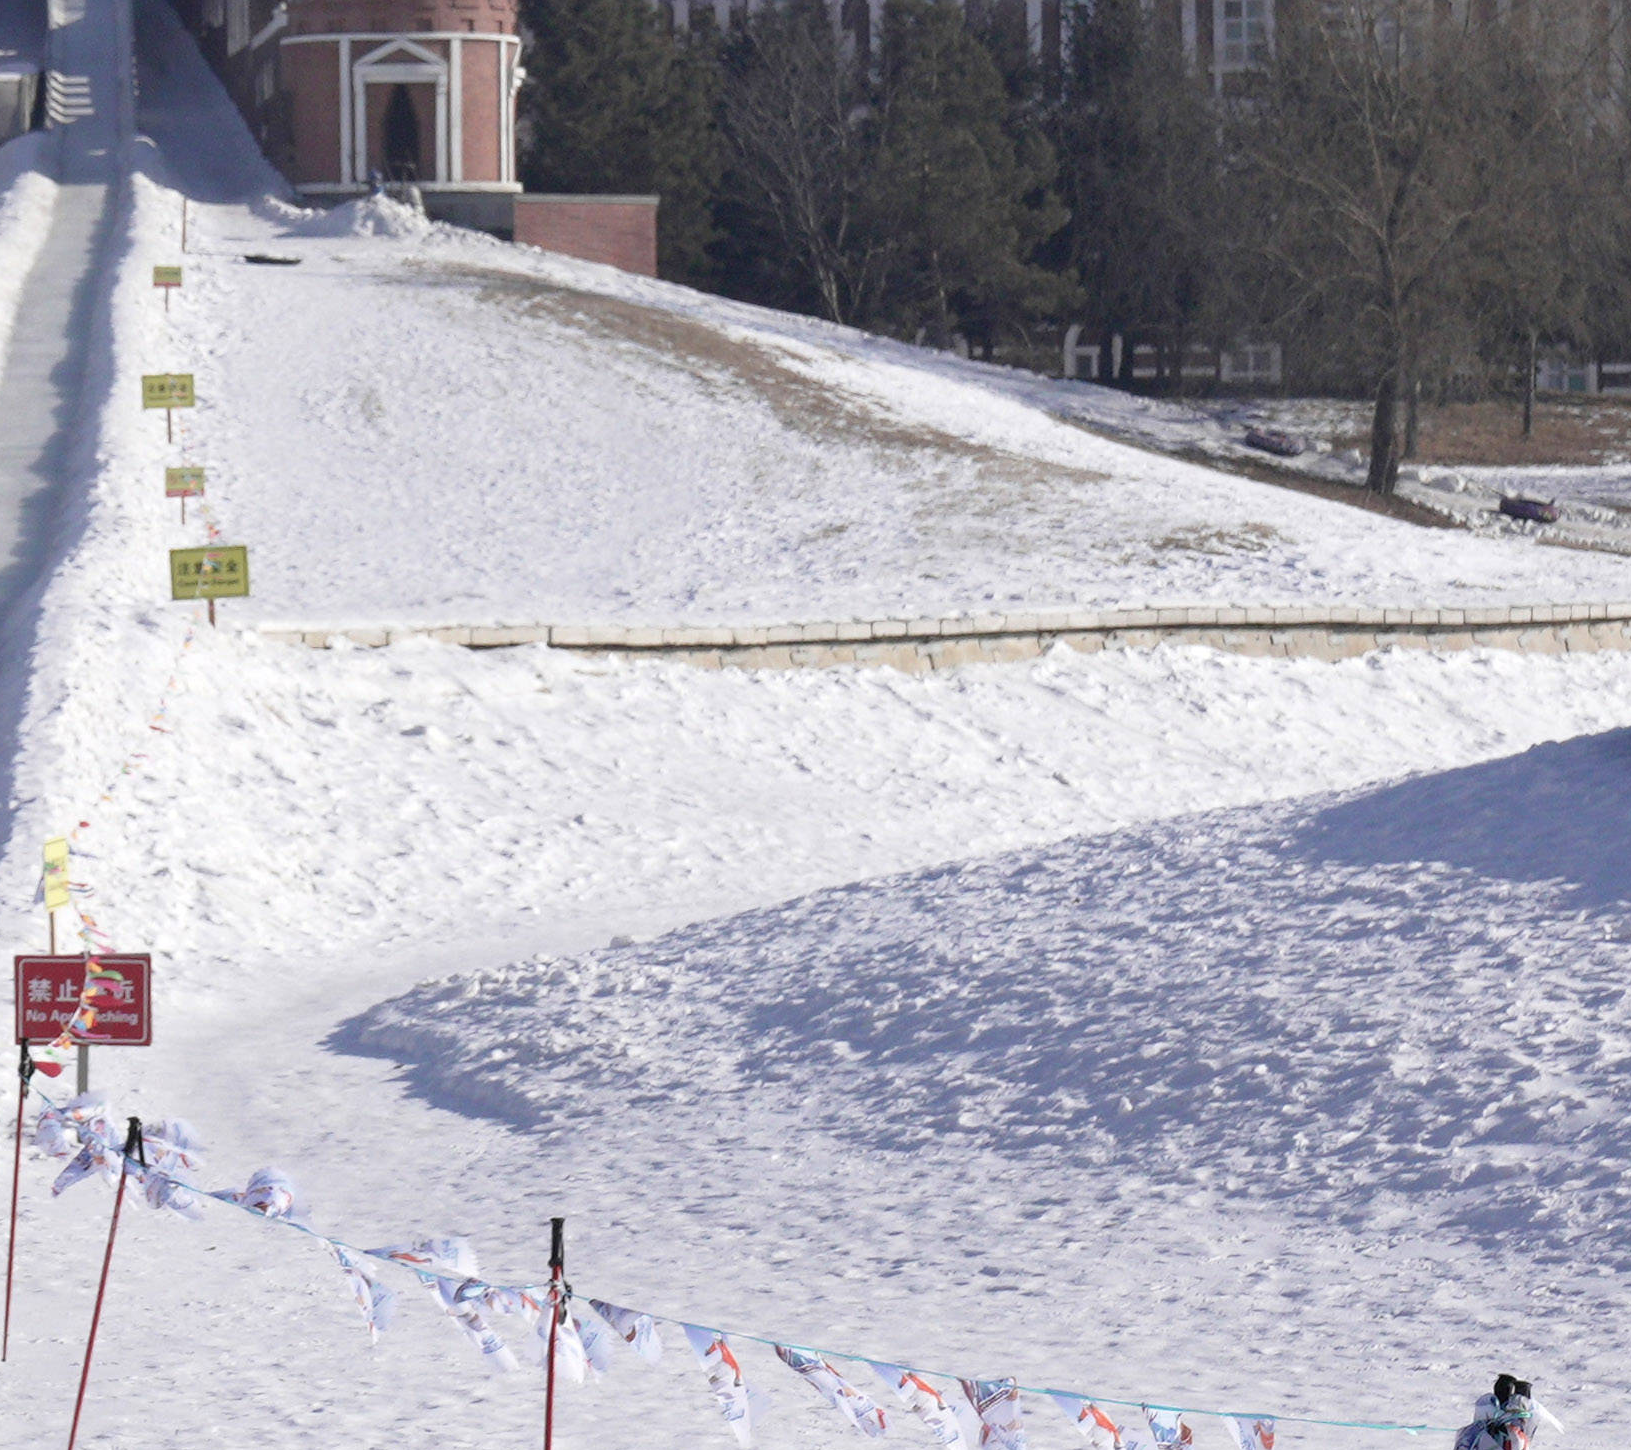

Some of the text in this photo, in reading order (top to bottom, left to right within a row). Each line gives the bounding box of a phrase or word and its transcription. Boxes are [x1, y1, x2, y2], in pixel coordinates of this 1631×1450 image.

[28, 976, 135, 1003] 禁止近
[26, 1010, 46, 1022] No
